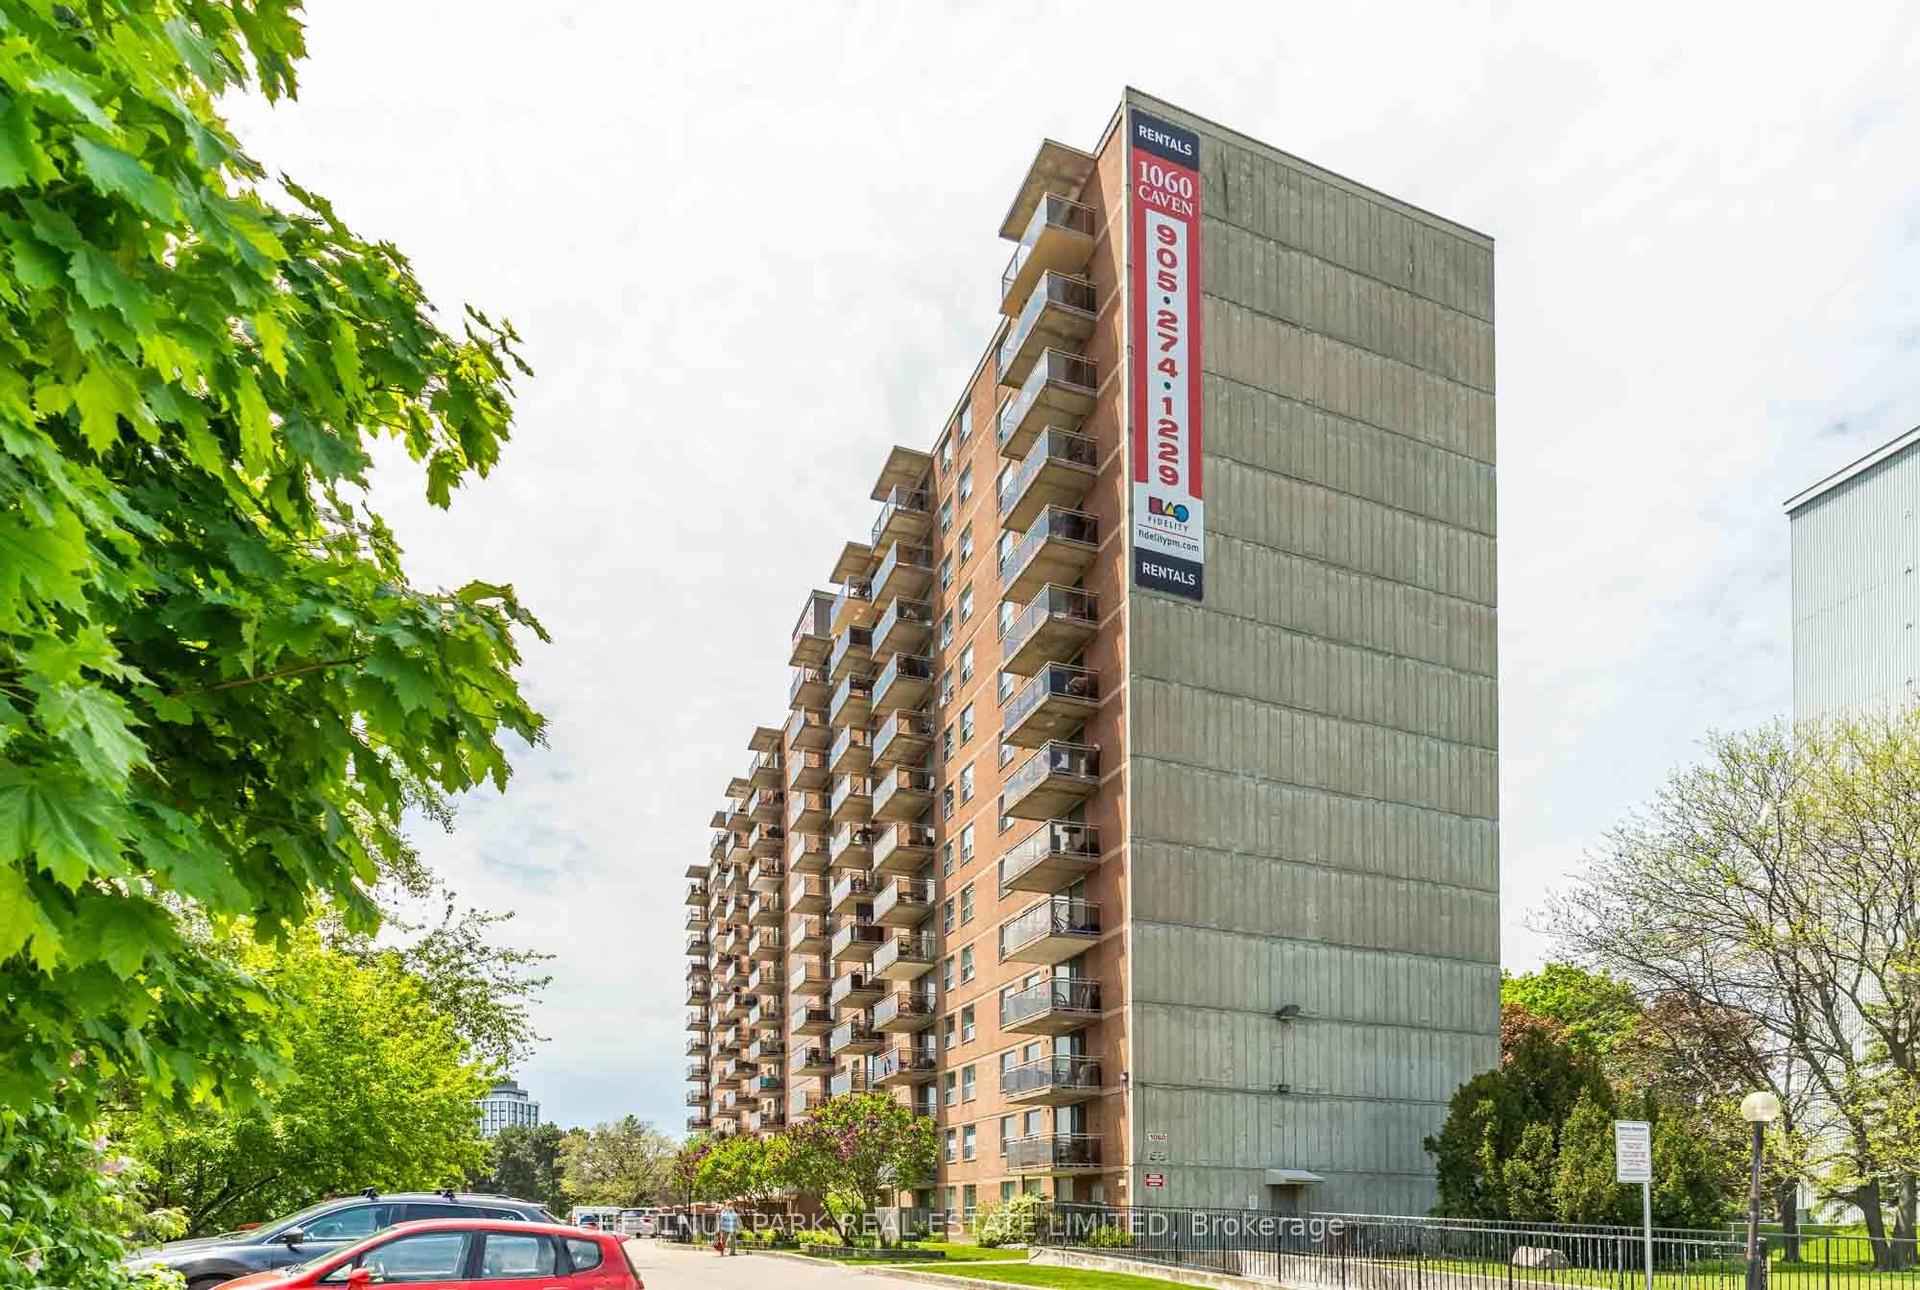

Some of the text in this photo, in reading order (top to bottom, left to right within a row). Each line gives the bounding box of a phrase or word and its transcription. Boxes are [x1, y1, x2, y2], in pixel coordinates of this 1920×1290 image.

[1139, 124, 1192, 156] RENTALS
[1139, 161, 1193, 199] 1060
[1138, 184, 1194, 216] CAVEN
[1147, 516, 1188, 532] FIDELITY
[1138, 529, 1199, 552] fidelitypm.com
[1142, 561, 1195, 586] RENTALS
